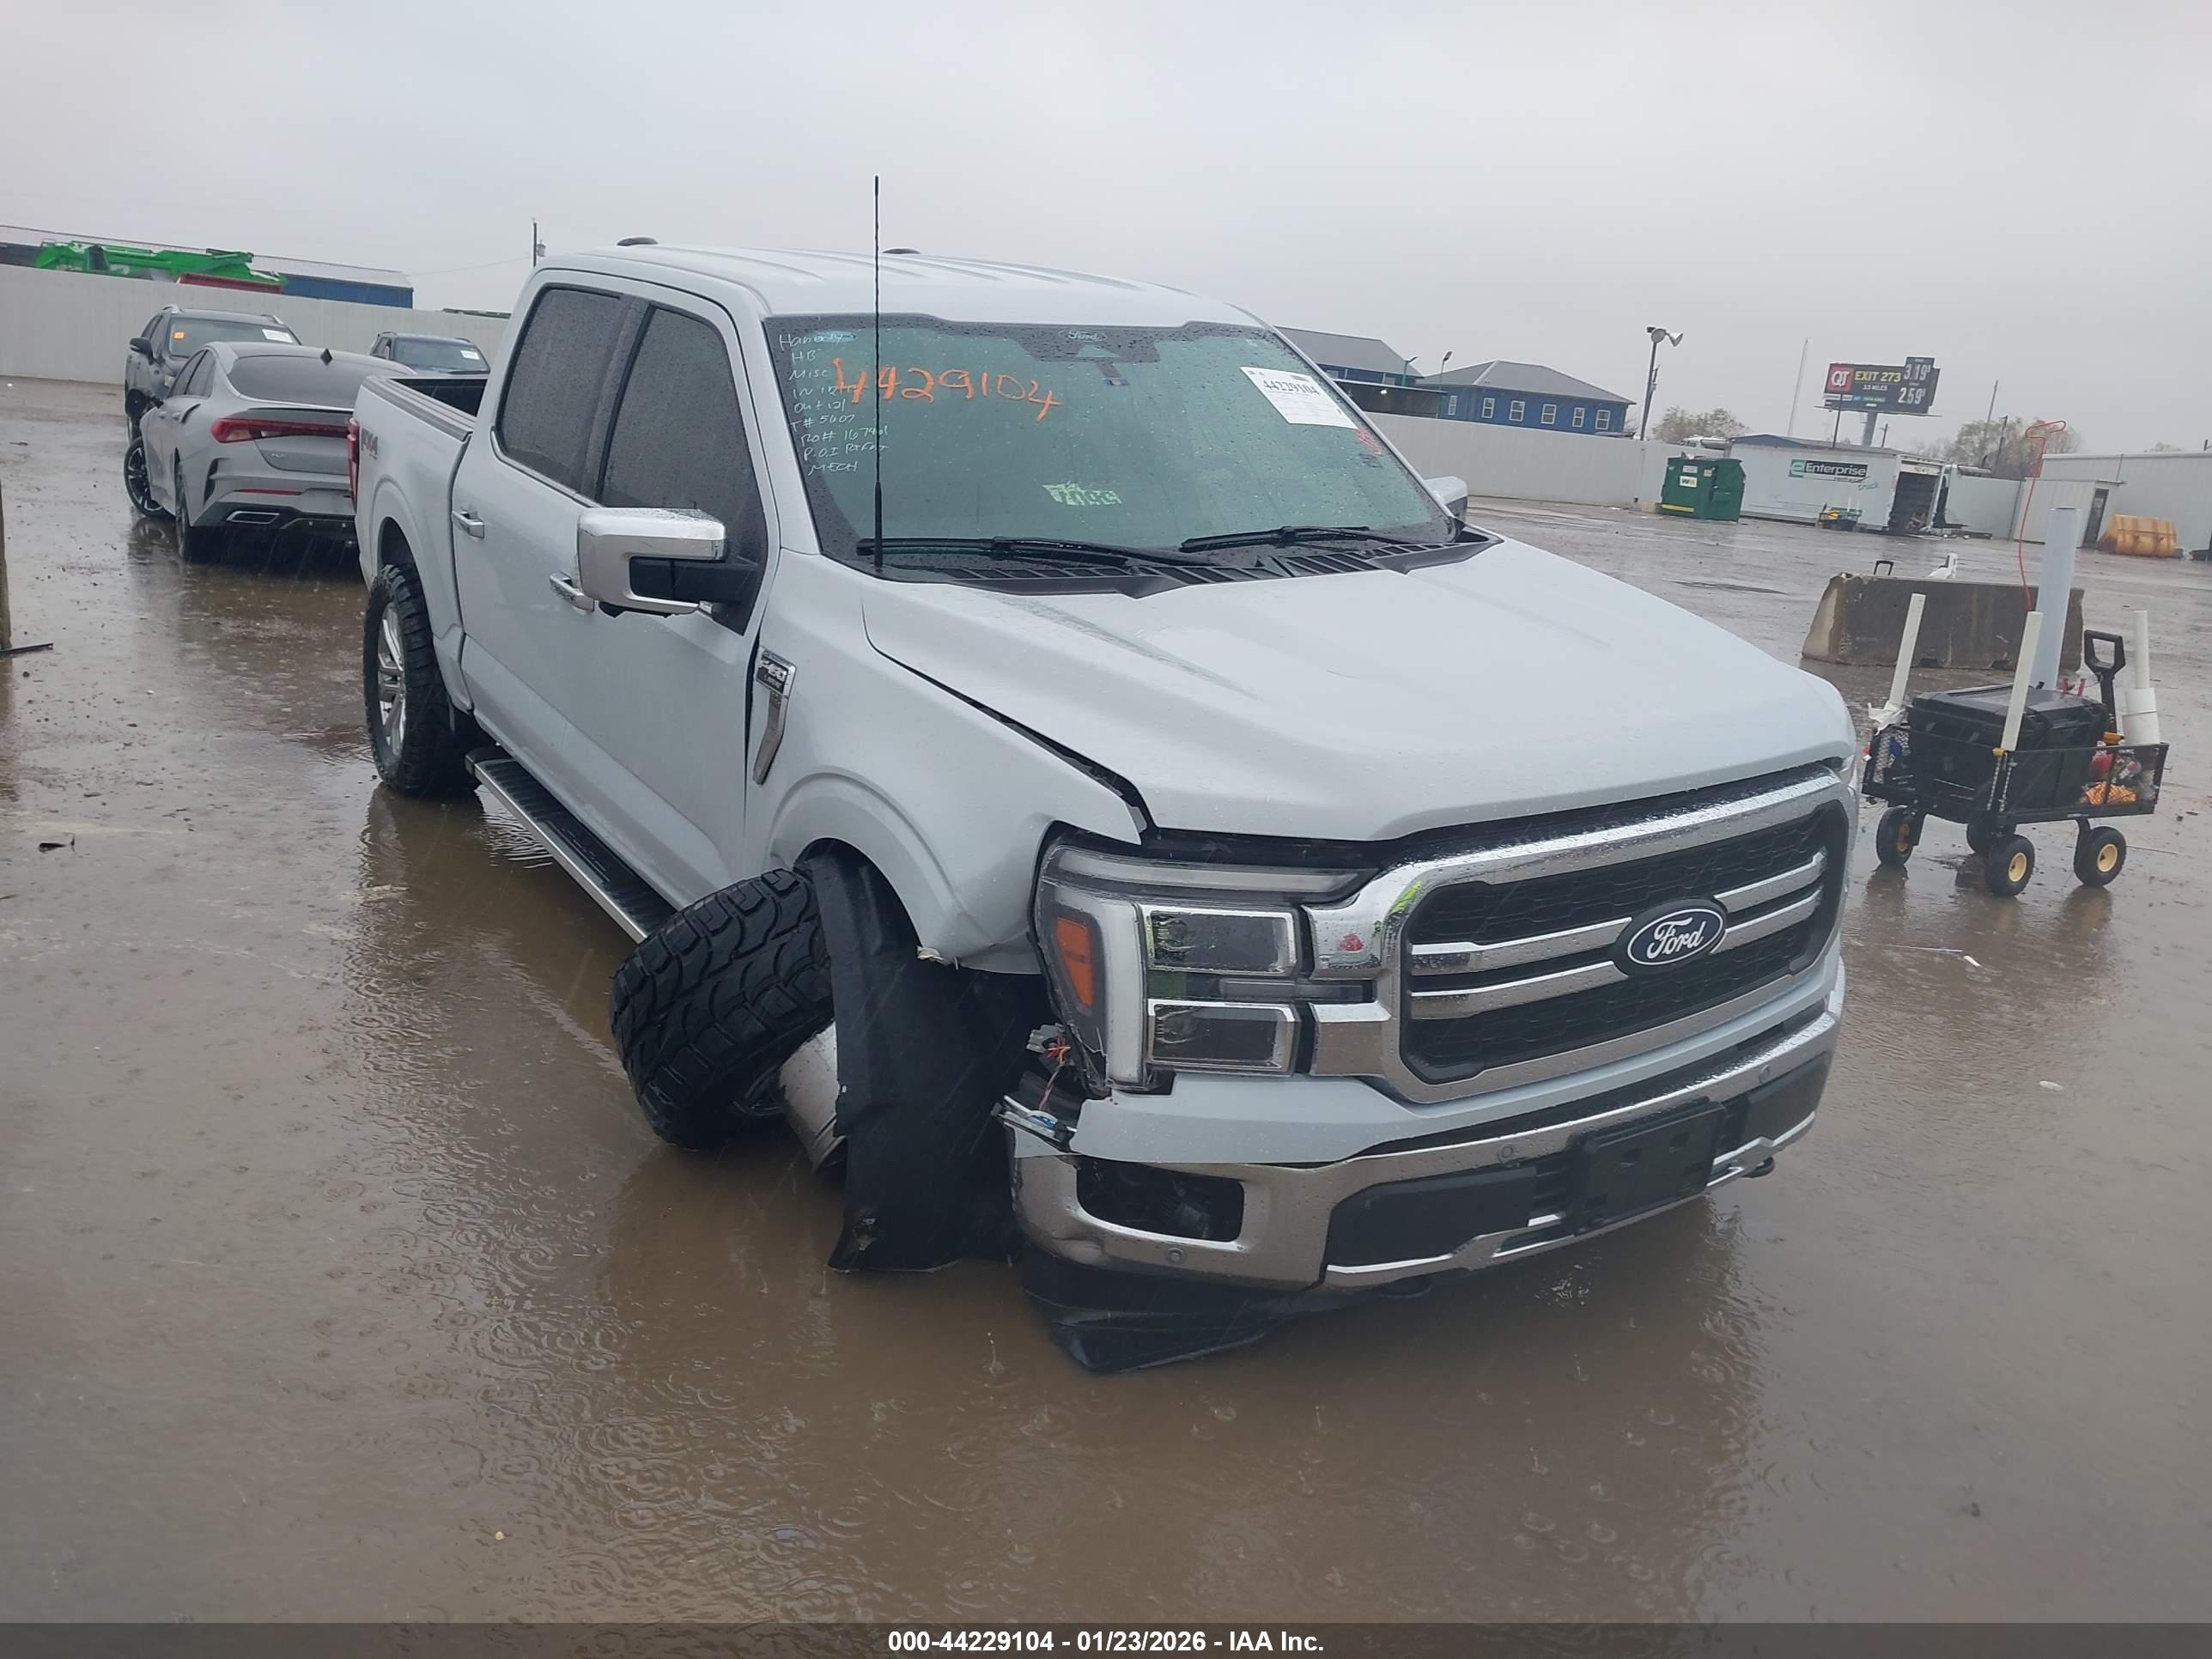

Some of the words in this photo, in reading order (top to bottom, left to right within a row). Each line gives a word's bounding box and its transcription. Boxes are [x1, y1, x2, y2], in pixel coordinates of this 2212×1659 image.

[1831, 370, 1850, 386] QT
[1854, 371, 1879, 381] EXIT
[1880, 372, 1902, 382] 273
[832, 356, 1061, 422] 4429104
[1263, 380, 1321, 396] 44229104
[1806, 464, 1866, 477] Enterprise
[1647, 917, 1706, 958] Ford
